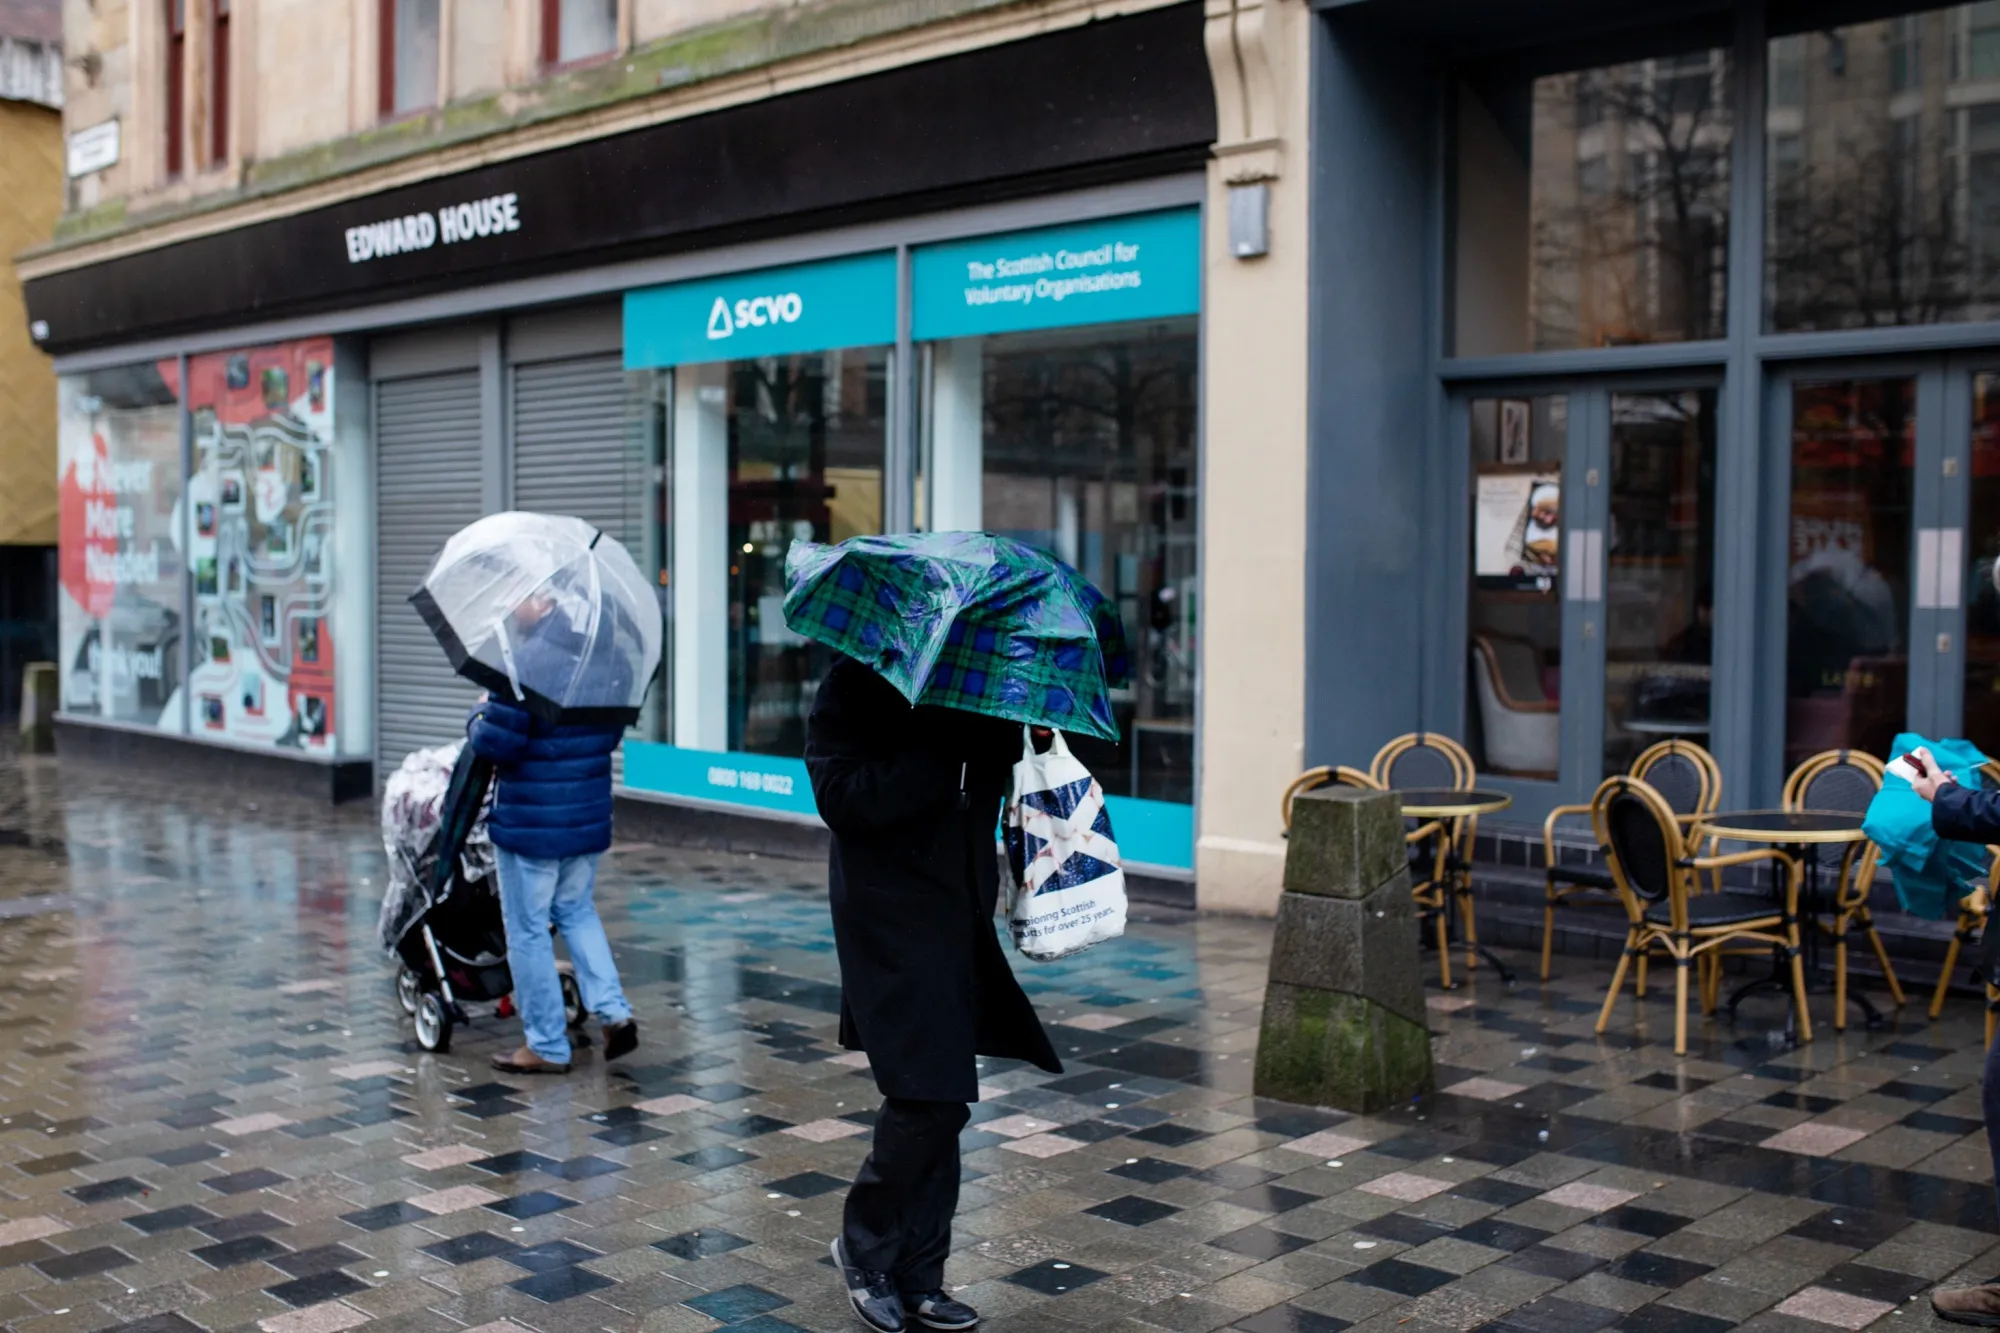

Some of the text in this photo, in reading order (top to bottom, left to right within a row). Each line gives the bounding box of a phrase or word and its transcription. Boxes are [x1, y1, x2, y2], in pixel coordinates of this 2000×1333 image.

[345, 192, 521, 263] EDWARD HOUSE
[967, 241, 1140, 282] The Scottish Council for
[964, 270, 1142, 305] Voluntary Organisations
[734, 292, 803, 329] SCVO
[1058, 918, 1079, 931] over
[1081, 914, 1092, 925] 25
[1061, 900, 1096, 917] Scottish
